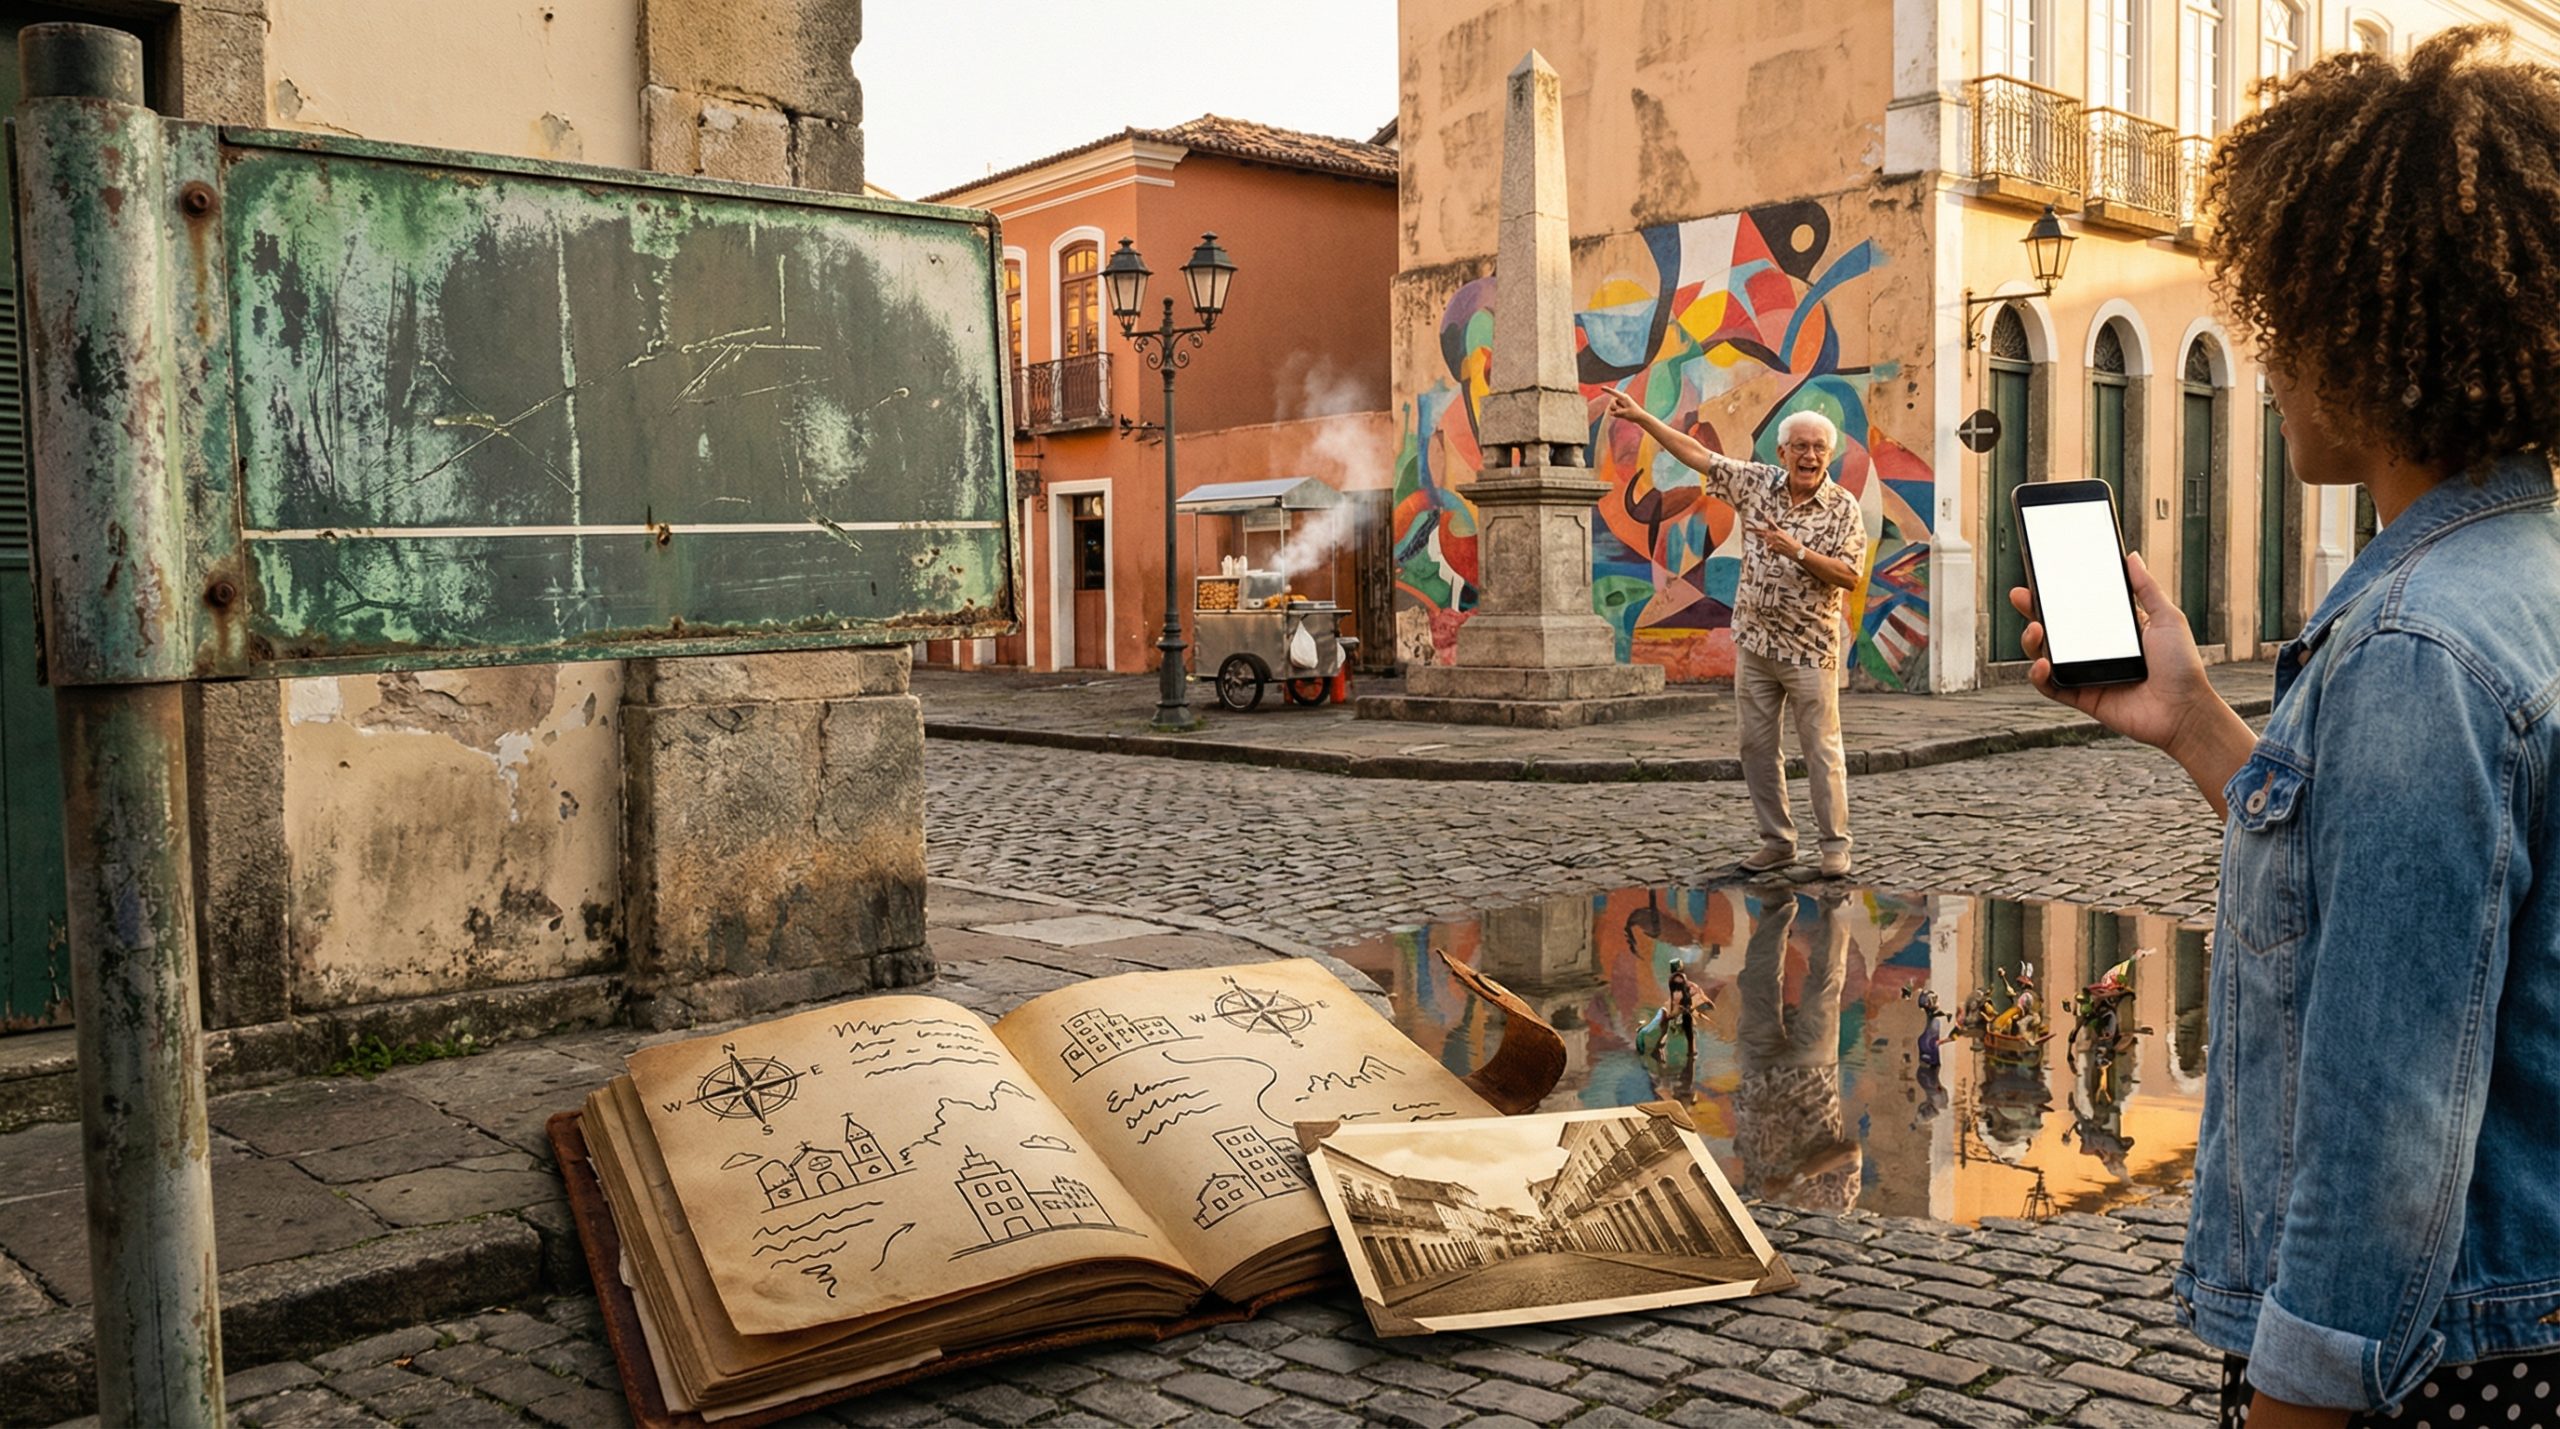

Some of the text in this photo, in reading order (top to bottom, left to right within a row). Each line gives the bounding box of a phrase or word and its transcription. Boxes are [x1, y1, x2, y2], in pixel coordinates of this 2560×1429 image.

[1188, 1013, 1206, 1023] W
[722, 1042, 736, 1054] N
[810, 1063, 823, 1076] E
[662, 1100, 682, 1113] W
[761, 1124, 774, 1136] S
